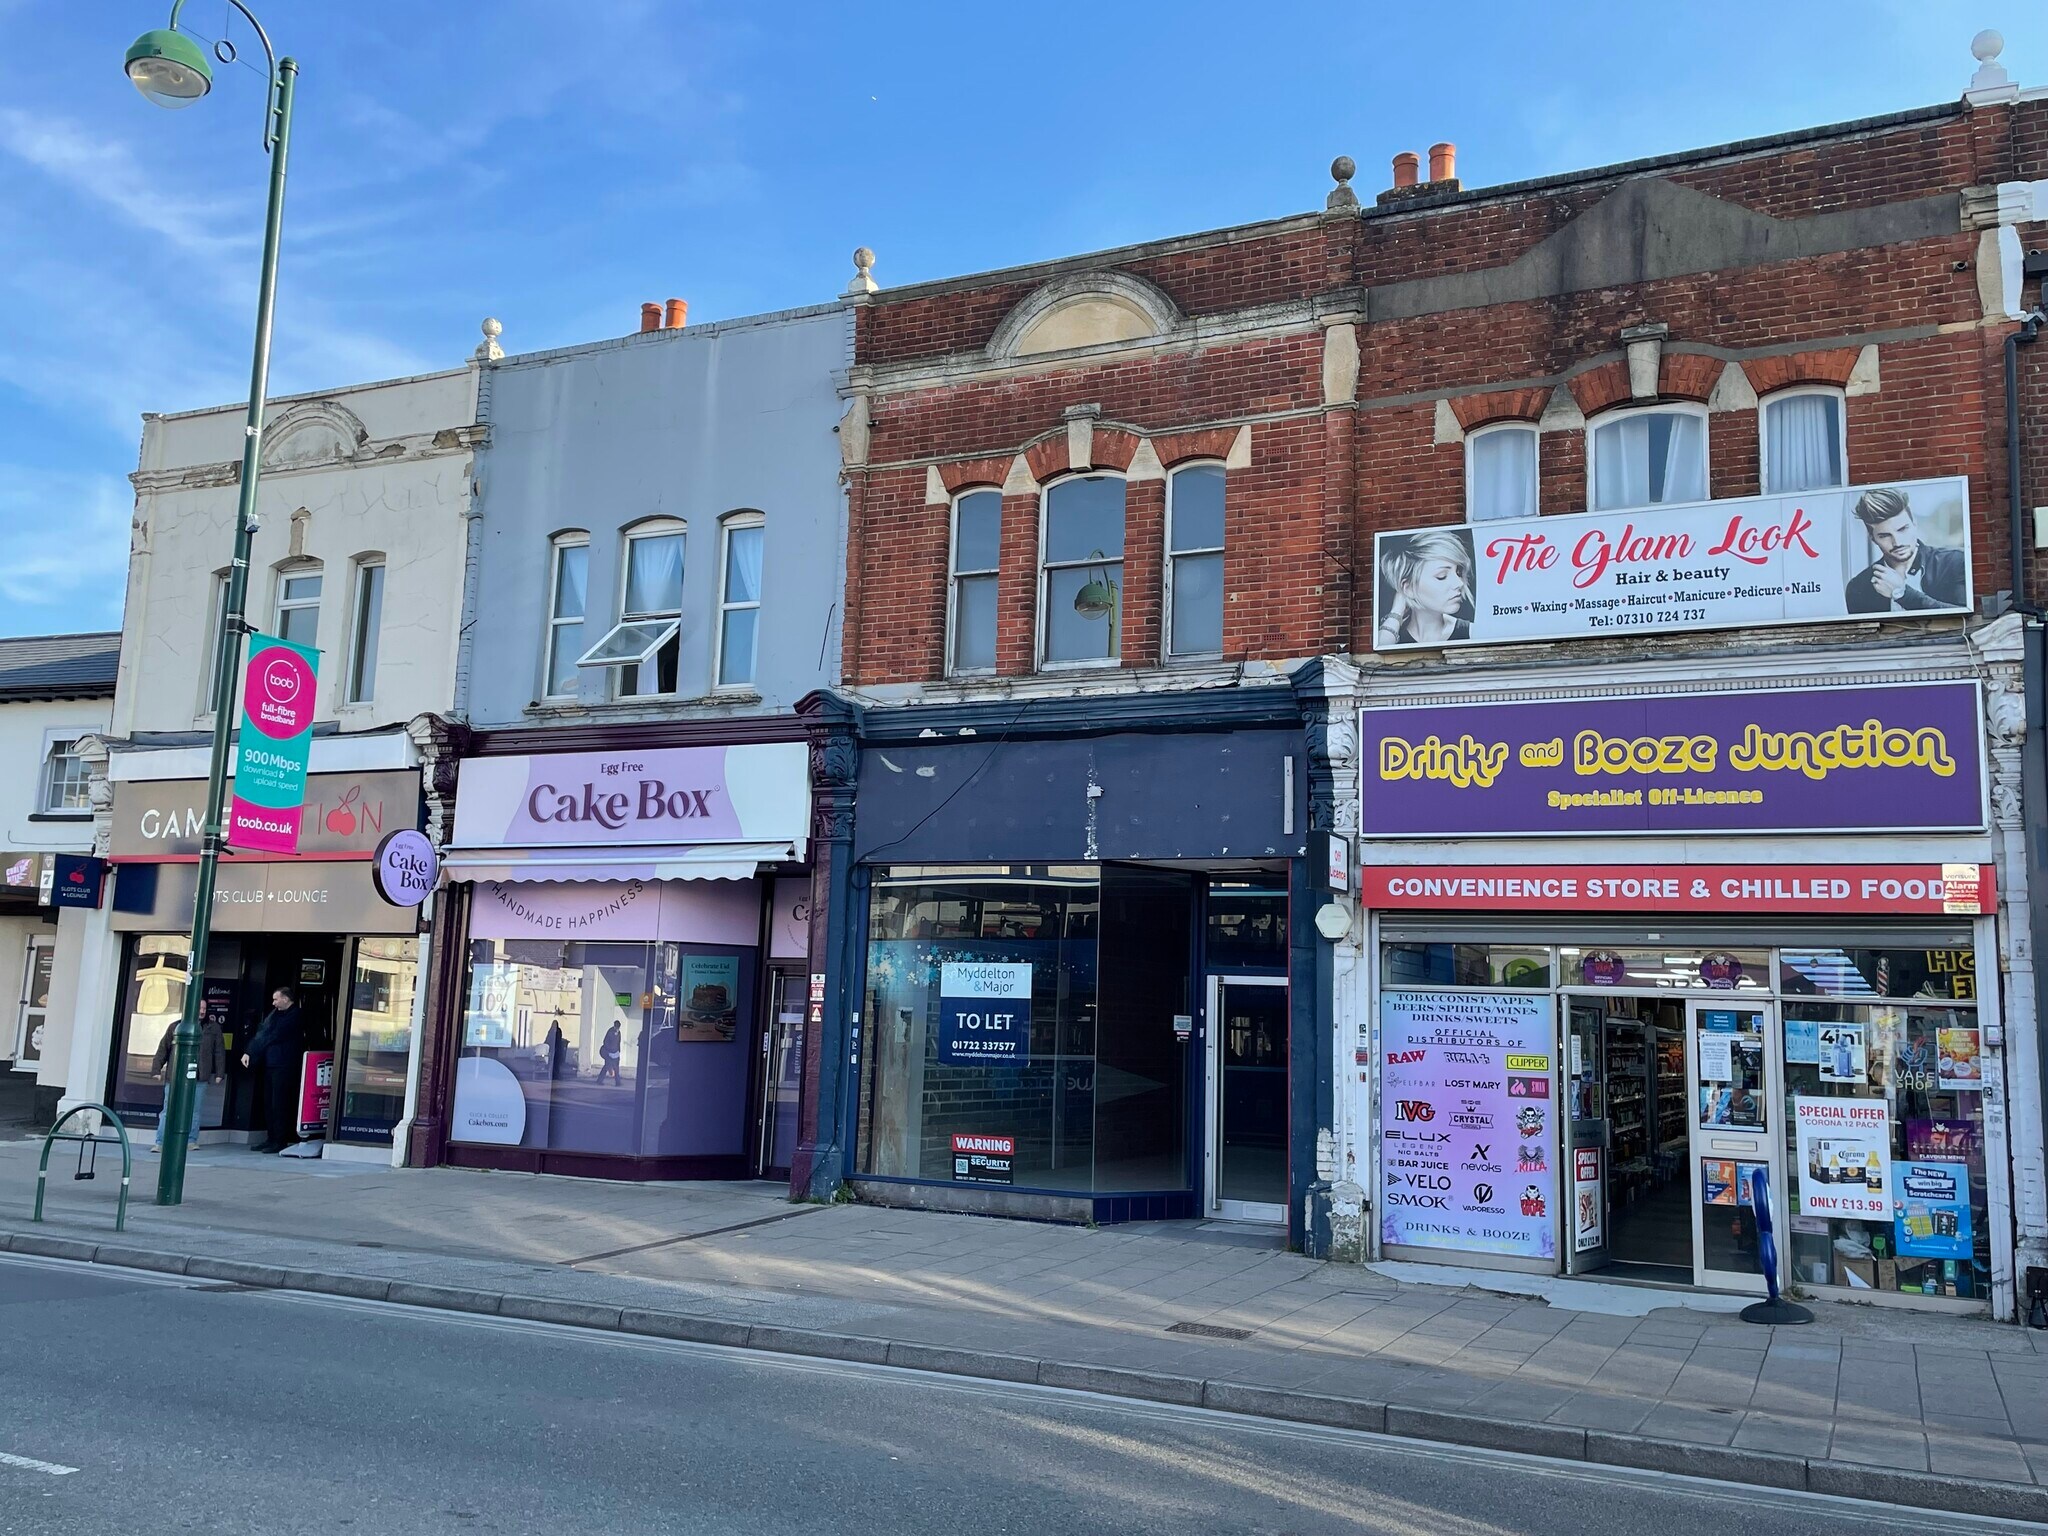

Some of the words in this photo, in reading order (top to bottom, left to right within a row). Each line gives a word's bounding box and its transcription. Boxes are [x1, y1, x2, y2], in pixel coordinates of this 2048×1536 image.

[1486, 533, 1560, 585] The
[1571, 524, 1696, 589] Glam
[1707, 508, 1820, 565] Look
[1615, 571, 1651, 586] Hair
[1655, 569, 1669, 583] &
[1672, 566, 1731, 582] beauty
[1492, 603, 1523, 616] Brows
[1530, 600, 1567, 614] Waxing
[1574, 596, 1620, 610] Massage
[1627, 593, 1667, 606] Haircut
[1674, 589, 1726, 603] Manicure
[1734, 585, 1783, 599] Pedicure
[1791, 581, 1821, 595] Nails
[1589, 615, 1613, 628] Tel:
[1616, 611, 1654, 626] 07310
[1657, 610, 1680, 623] 724
[1683, 608, 1706, 622] 737
[270, 673, 294, 689] toob
[261, 701, 297, 718] full-fibre
[260, 711, 296, 726] broadband
[1380, 734, 1509, 788] Drinks
[1519, 737, 1564, 767] and
[1574, 729, 1718, 775] Booze
[1729, 719, 1956, 780] Junction
[243, 764, 278, 778] download
[278, 770, 285, 779] &
[601, 762, 619, 775] Egg
[621, 761, 644, 773] Free
[253, 777, 277, 788] upload
[278, 781, 299, 792] speed
[528, 782, 629, 830] Cake
[636, 779, 713, 820] Box
[1547, 789, 1643, 810] Specialist
[1648, 787, 1764, 806] Off-Licence
[237, 815, 293, 835] toob.co.uk
[388, 850, 428, 876] Cake
[1334, 850, 1342, 862] Off
[400, 870, 429, 891] Box
[1945, 881, 1979, 890] Alarm
[60, 885, 77, 893] SLOTS
[1388, 878, 1578, 898] CONVENIENCE
[1586, 878, 1680, 899] STORE
[1690, 879, 1711, 899] &
[1720, 879, 1851, 899] CHILLED
[232, 890, 264, 903] CLUB
[277, 890, 328, 903] LOUNGE
[491, 882, 562, 929] HANDMADE
[568, 881, 644, 929] HAPPINESS
[957, 966, 1015, 981] Myddelton
[477, 992, 508, 1013] 10%
[1396, 993, 1534, 1005] TOBACCONIST/VAPES
[1393, 1003, 1538, 1015] BEERS/SPIRITS/WINES
[956, 1013, 980, 1029] TO
[985, 1013, 1014, 1030] LET
[1411, 1013, 1519, 1025] DRINKS/SWEETS
[1434, 1028, 1495, 1038] OFFICIAL
[952, 1040, 980, 1050] 01722
[982, 1041, 1016, 1051] 337577
[1407, 1035, 1501, 1047] DISTRIBUTORS
[1386, 1050, 1427, 1065] RAW
[1509, 1058, 1546, 1069] CLIPPER
[1894, 1069, 1935, 1080] VAPE
[1445, 1079, 1471, 1088] LOST
[1472, 1081, 1501, 1090] MARY
[1896, 1080, 1934, 1090] SHOP
[1395, 1100, 1436, 1122] IVG
[1799, 1105, 1846, 1118] SPECIAL
[1849, 1107, 1885, 1120] OFFER
[468, 1118, 508, 1128] Cakebox.com
[1453, 1114, 1491, 1125] CRYSTAL
[1805, 1118, 1843, 1127] CORONA
[1856, 1121, 1880, 1129] PACK
[1385, 1130, 1451, 1143] ELUX
[955, 1136, 1011, 1152] WARNING
[1393, 1142, 1443, 1151] LEGEND
[1577, 1151, 1597, 1165] SPECIAL
[1838, 1150, 1866, 1159] Corona
[970, 1158, 1010, 1167] SECURITY
[1397, 1159, 1419, 1168] BAR
[1420, 1161, 1449, 1170] JUICE
[1460, 1162, 1502, 1173] nevoks
[1519, 1160, 1547, 1173] KILLA
[1580, 1166, 1595, 1179] OFFER
[1913, 1168, 1927, 1176] The
[1927, 1169, 1945, 1178] NEW
[1405, 1173, 1451, 1190] VELO
[1931, 1180, 1943, 1188] big
[1387, 1192, 1450, 1211] SMOK
[1908, 1190, 1954, 1199] Scratchcards
[1462, 1204, 1506, 1215] VAPORESSO
[1810, 1196, 1838, 1208] ONLY
[1842, 1198, 1883, 1212] £13.99
[1405, 1222, 1461, 1234] DRINKS
[1466, 1227, 1477, 1236] &
[1483, 1228, 1531, 1242] BOOZE
